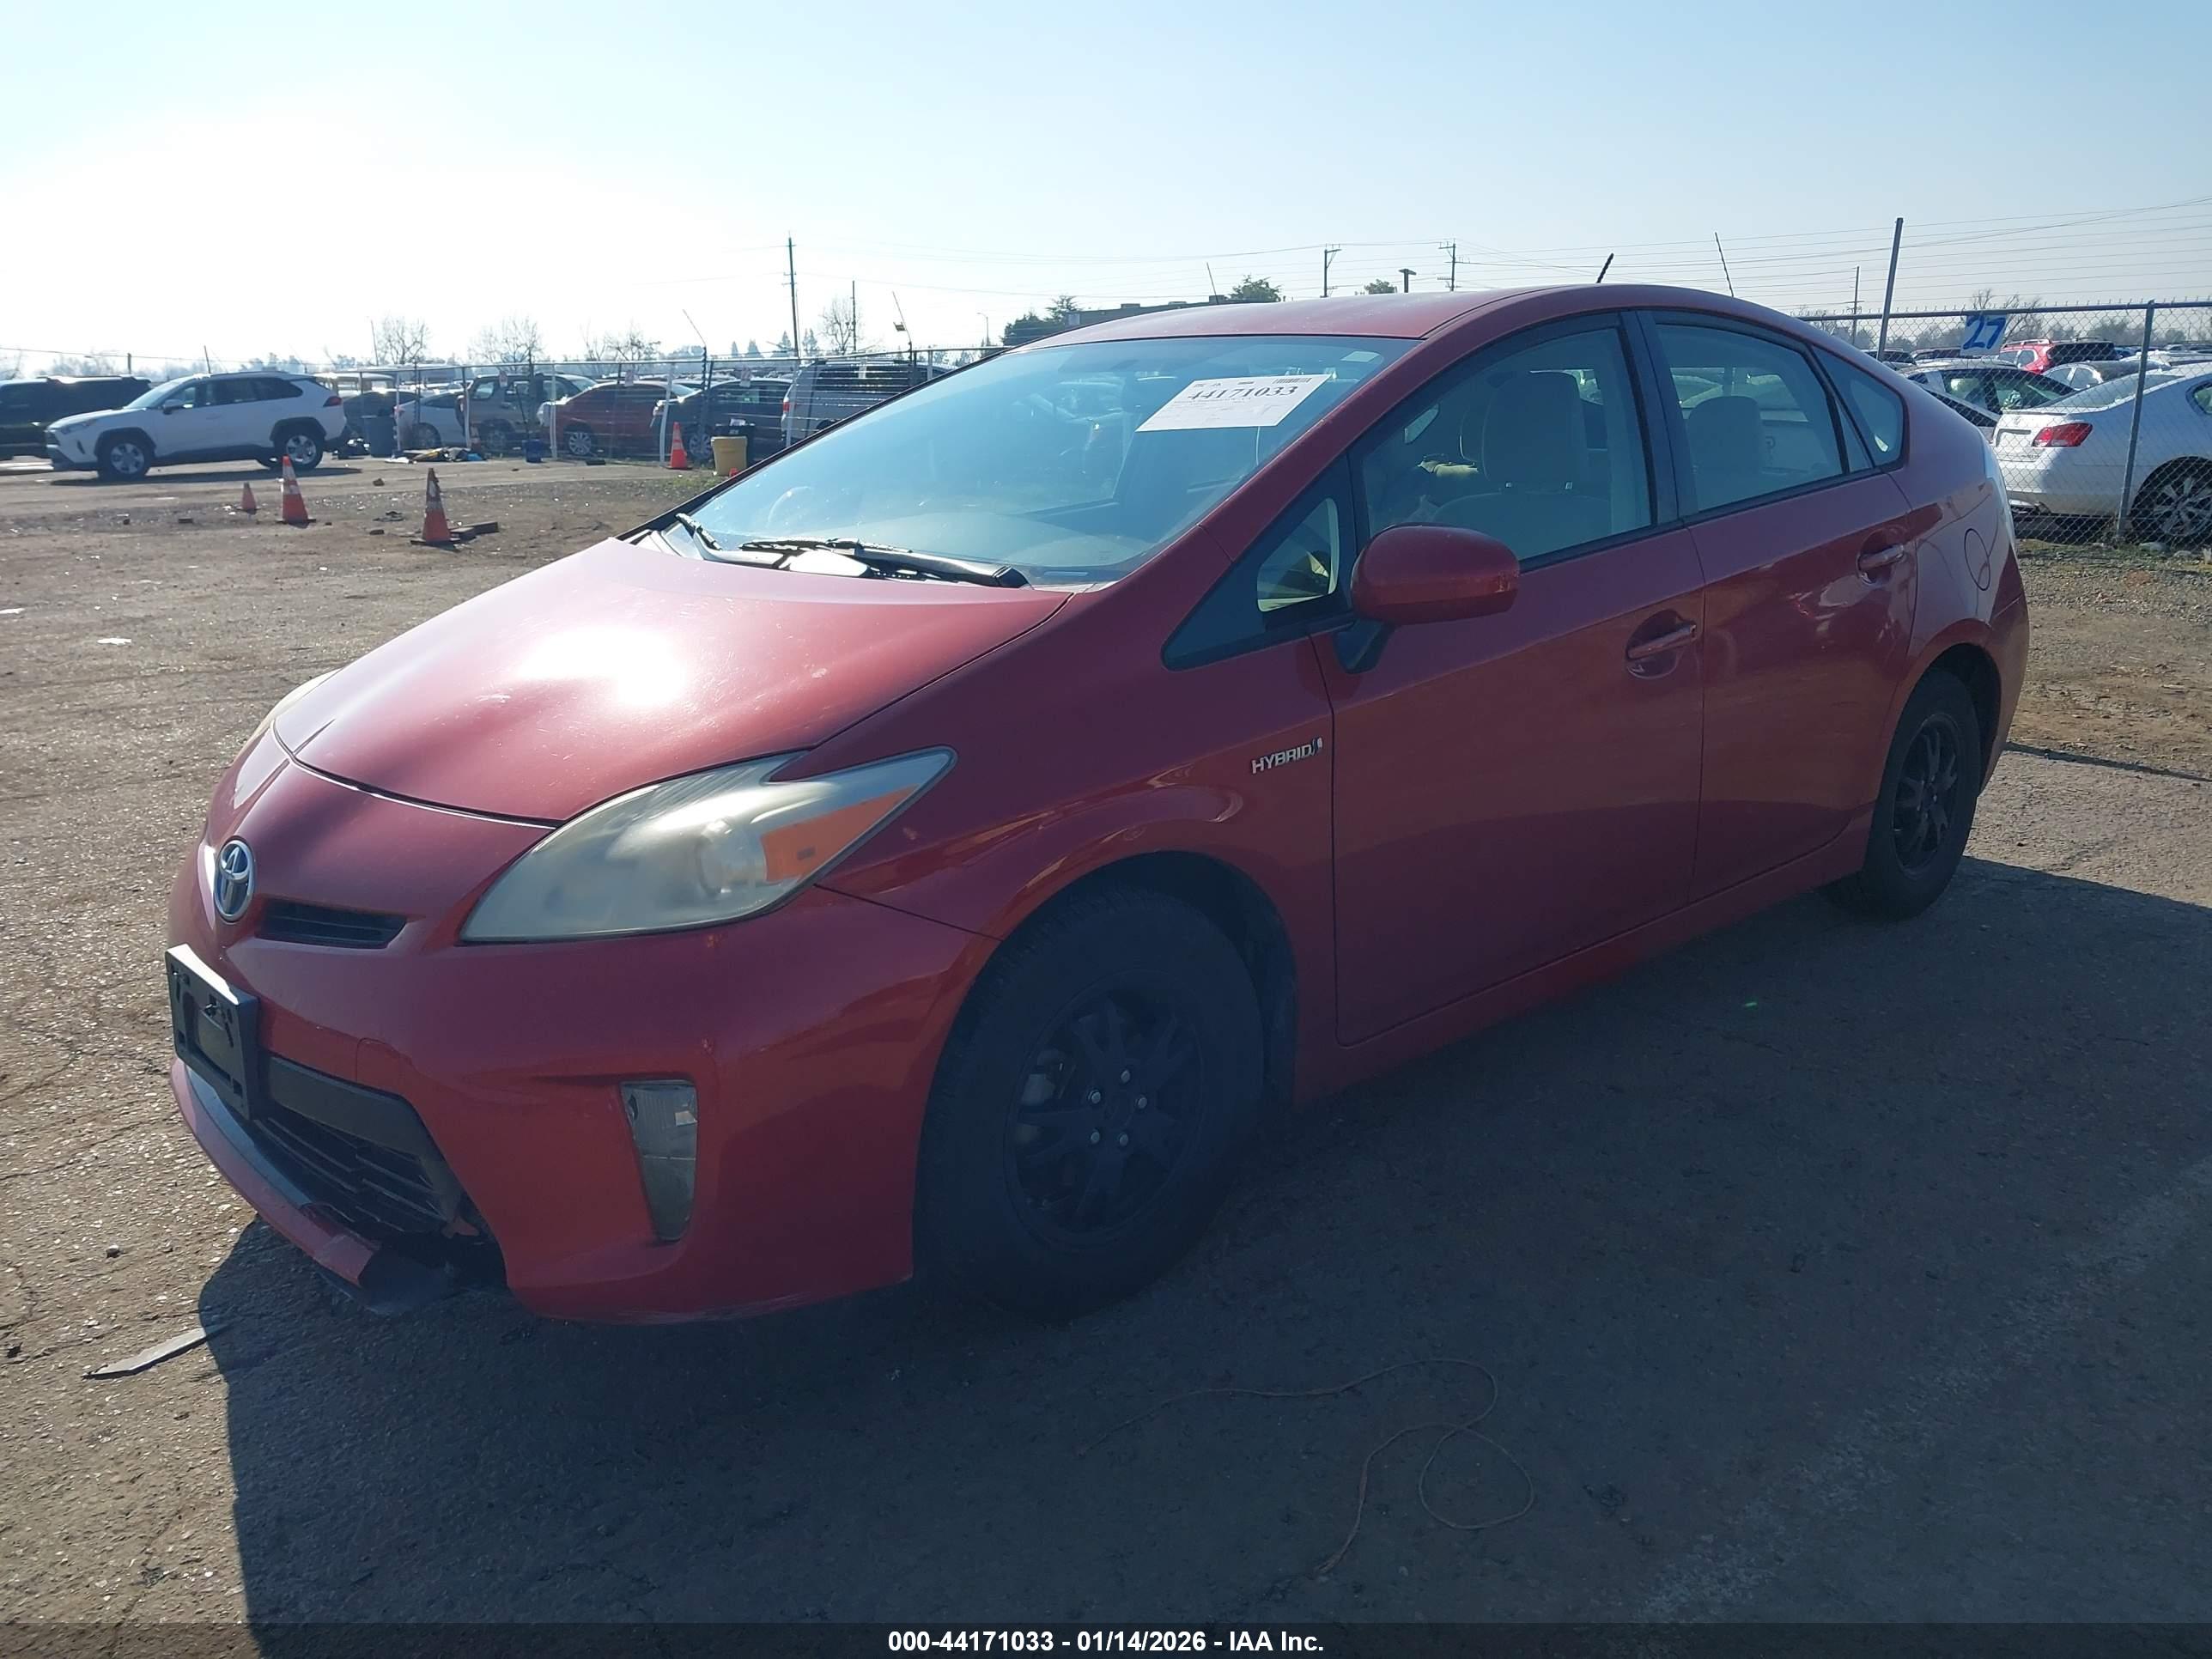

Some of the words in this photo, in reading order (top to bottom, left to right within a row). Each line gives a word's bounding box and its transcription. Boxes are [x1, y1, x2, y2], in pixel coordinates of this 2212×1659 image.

[1963, 315, 2006, 349] 27
[1188, 386, 1298, 400] 44171033
[1251, 744, 1313, 775] HYBRID
